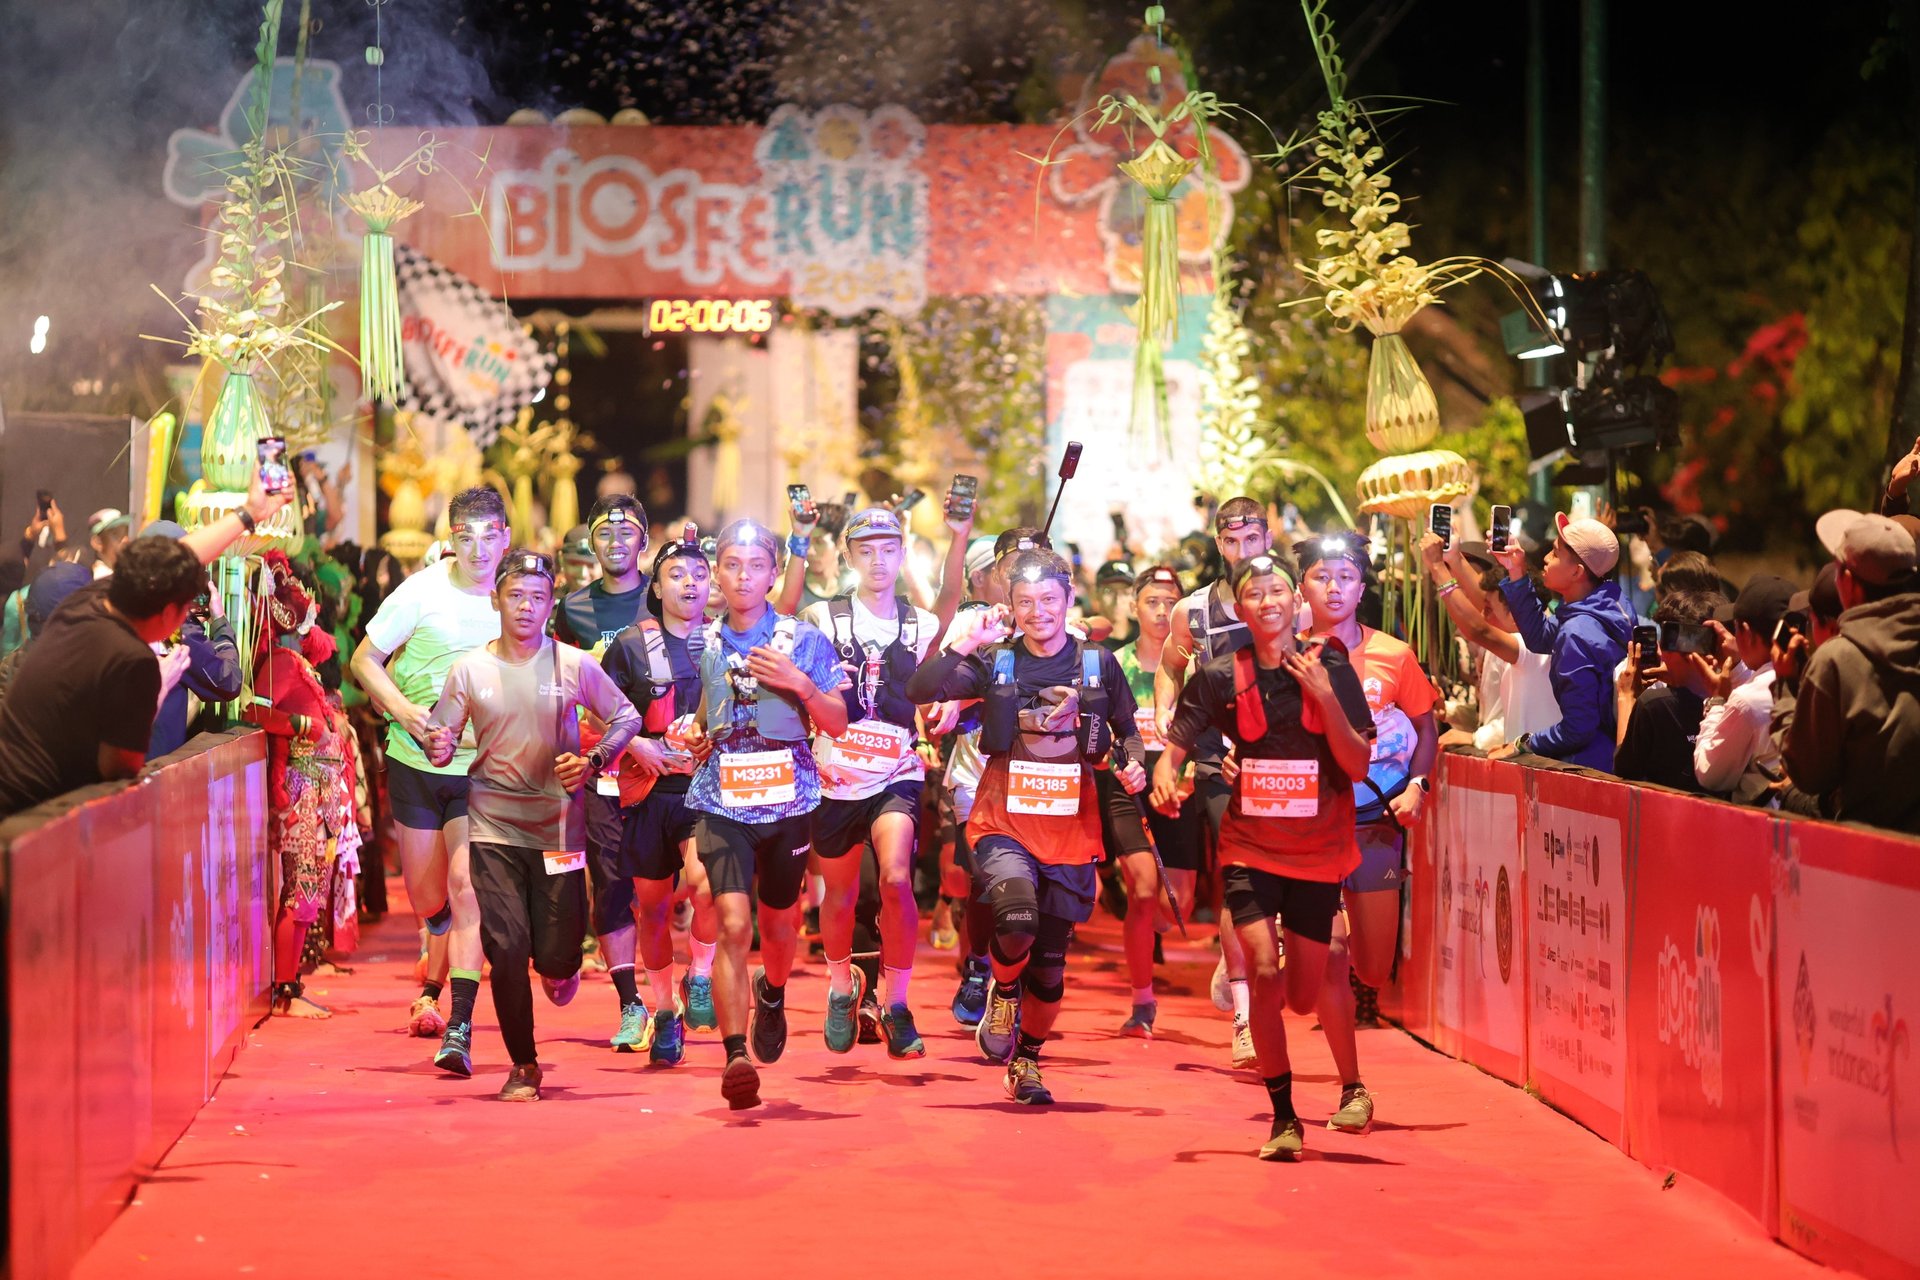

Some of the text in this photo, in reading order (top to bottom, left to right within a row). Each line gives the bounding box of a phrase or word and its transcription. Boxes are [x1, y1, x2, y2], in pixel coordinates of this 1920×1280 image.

[649, 299, 772, 332] 02:00:06
[845, 731, 892, 750] M3233
[1087, 713, 1101, 754] AONIJIE
[733, 766, 781, 782] M3231
[1022, 776, 1068, 791] M3185
[1252, 776, 1306, 791] M3003
